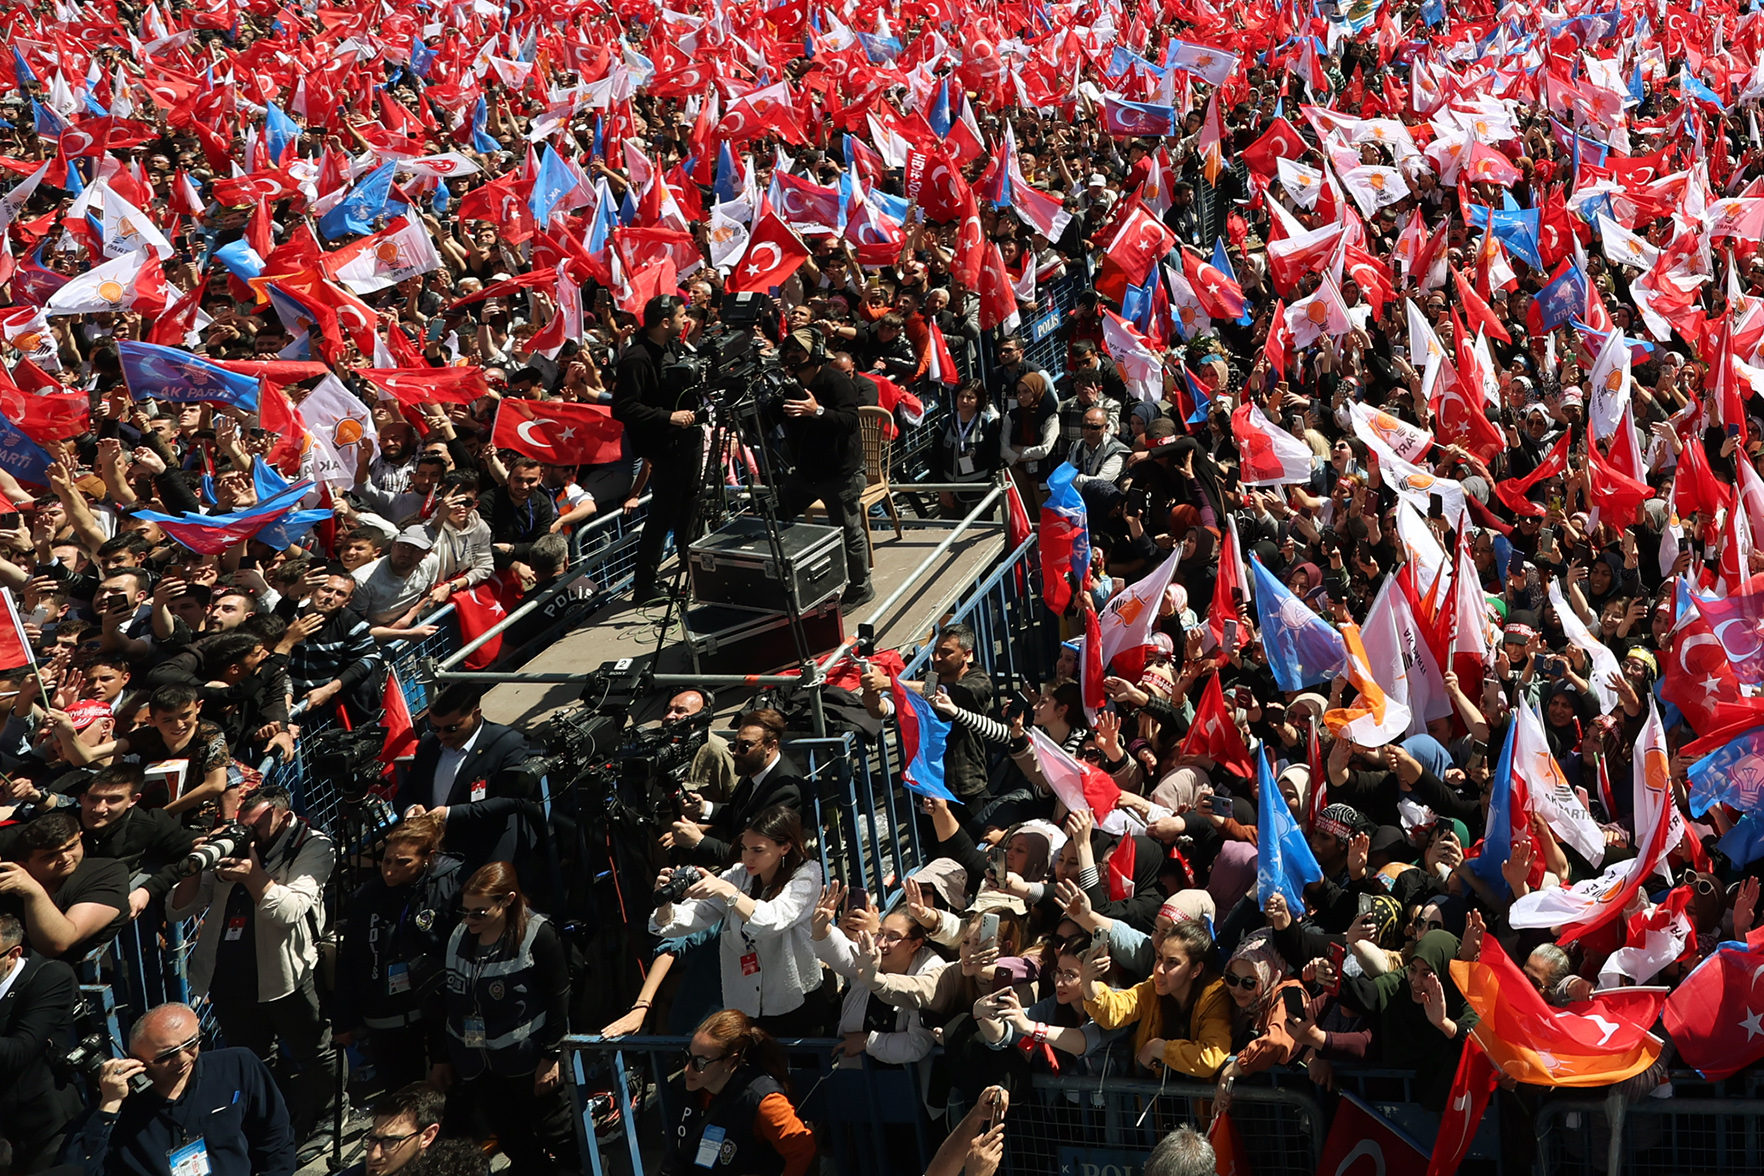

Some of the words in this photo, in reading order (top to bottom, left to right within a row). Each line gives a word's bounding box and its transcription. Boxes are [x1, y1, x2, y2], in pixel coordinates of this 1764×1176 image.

[1037, 312, 1059, 339] POLİS
[160, 386, 183, 398] AK
[0, 451, 33, 470] ARTİ
[543, 586, 594, 618] POLİS
[619, 660, 627, 668] 2
[1559, 804, 1592, 821] ARTİ
[1062, 1165, 1070, 1174] K
